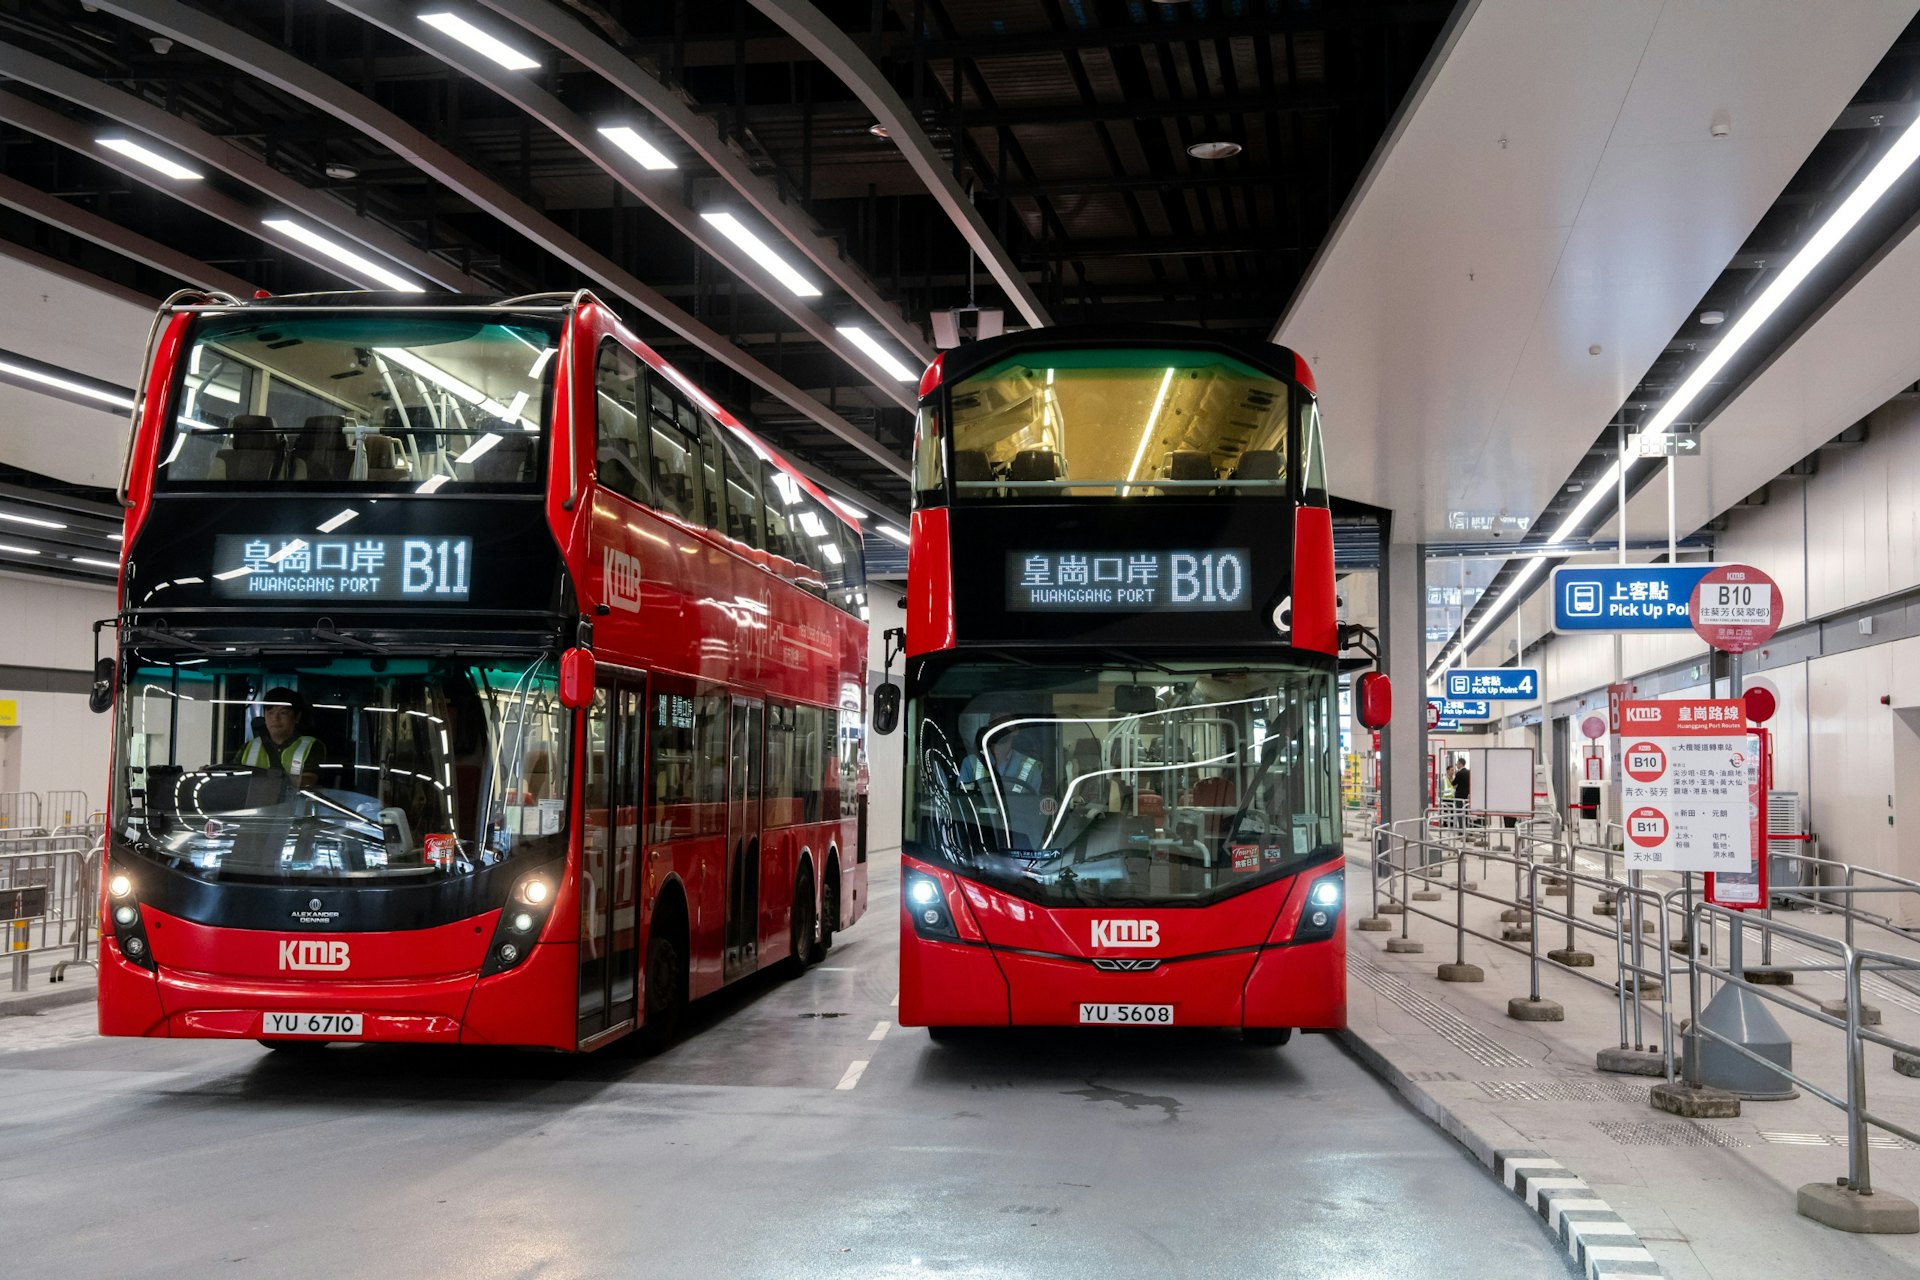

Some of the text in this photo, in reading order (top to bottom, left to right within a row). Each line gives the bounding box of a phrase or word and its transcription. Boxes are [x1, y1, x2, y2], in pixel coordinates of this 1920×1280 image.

[403, 541, 468, 593] B11
[1020, 554, 1159, 586] 皇崗口岸
[249, 577, 380, 592] HUANGGANG PORT
[603, 546, 642, 613] KMB
[1171, 554, 1242, 602] B10
[1031, 589, 1155, 603] HUANGGANG PORT
[1609, 581, 1669, 601] 上客點
[1719, 586, 1752, 606] B10
[1609, 602, 1690, 620] Pick Up Poi
[1472, 675, 1502, 686] 上客點
[1518, 675, 1533, 694] 4
[1472, 686, 1518, 695] Pick Up Point
[1476, 701, 1487, 715] 3
[1626, 707, 1662, 721] KMB
[1677, 706, 1740, 721] 皇崗路線
[1677, 722, 1708, 730] Huanggang
[1633, 757, 1657, 768] B10
[1637, 822, 1658, 832] B11
[1267, 850, 1278, 858] 5G
[1091, 919, 1161, 948] KMB
[279, 940, 351, 972] KMB
[1083, 1005, 1170, 1022] YU 5608
[272, 1014, 354, 1033] YU 6710
